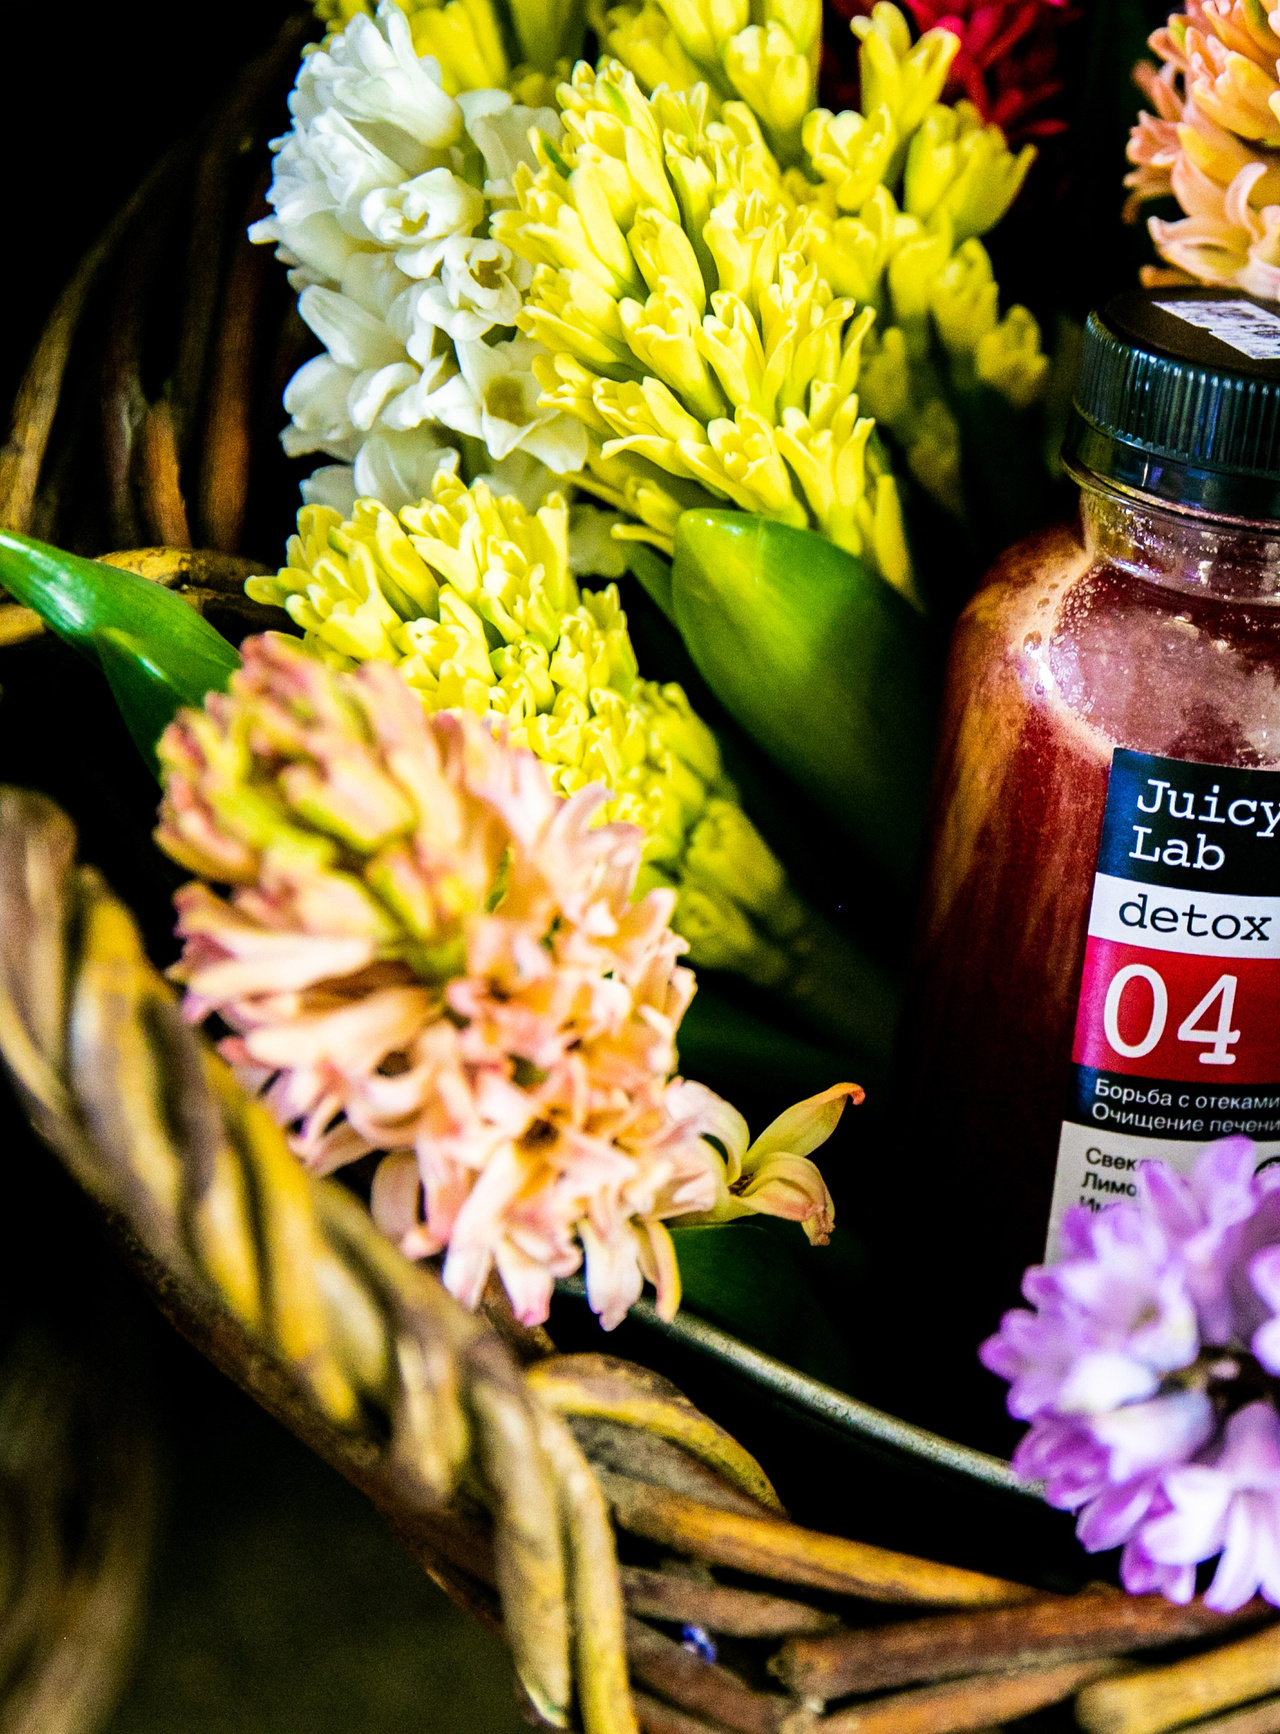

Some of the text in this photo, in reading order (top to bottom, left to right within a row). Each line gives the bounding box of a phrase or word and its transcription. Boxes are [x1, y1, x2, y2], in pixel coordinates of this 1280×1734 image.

[1128, 825, 1225, 871] Lab
[1118, 894, 1272, 941] detox
[1104, 963, 1241, 1065] 04
[1095, 1078, 1172, 1107] Борьба
[1178, 1094, 1190, 1107] с
[1195, 1097, 1280, 1110] отеками
[1092, 1102, 1204, 1132] Очищение
[1085, 1147, 1153, 1172] Свек
